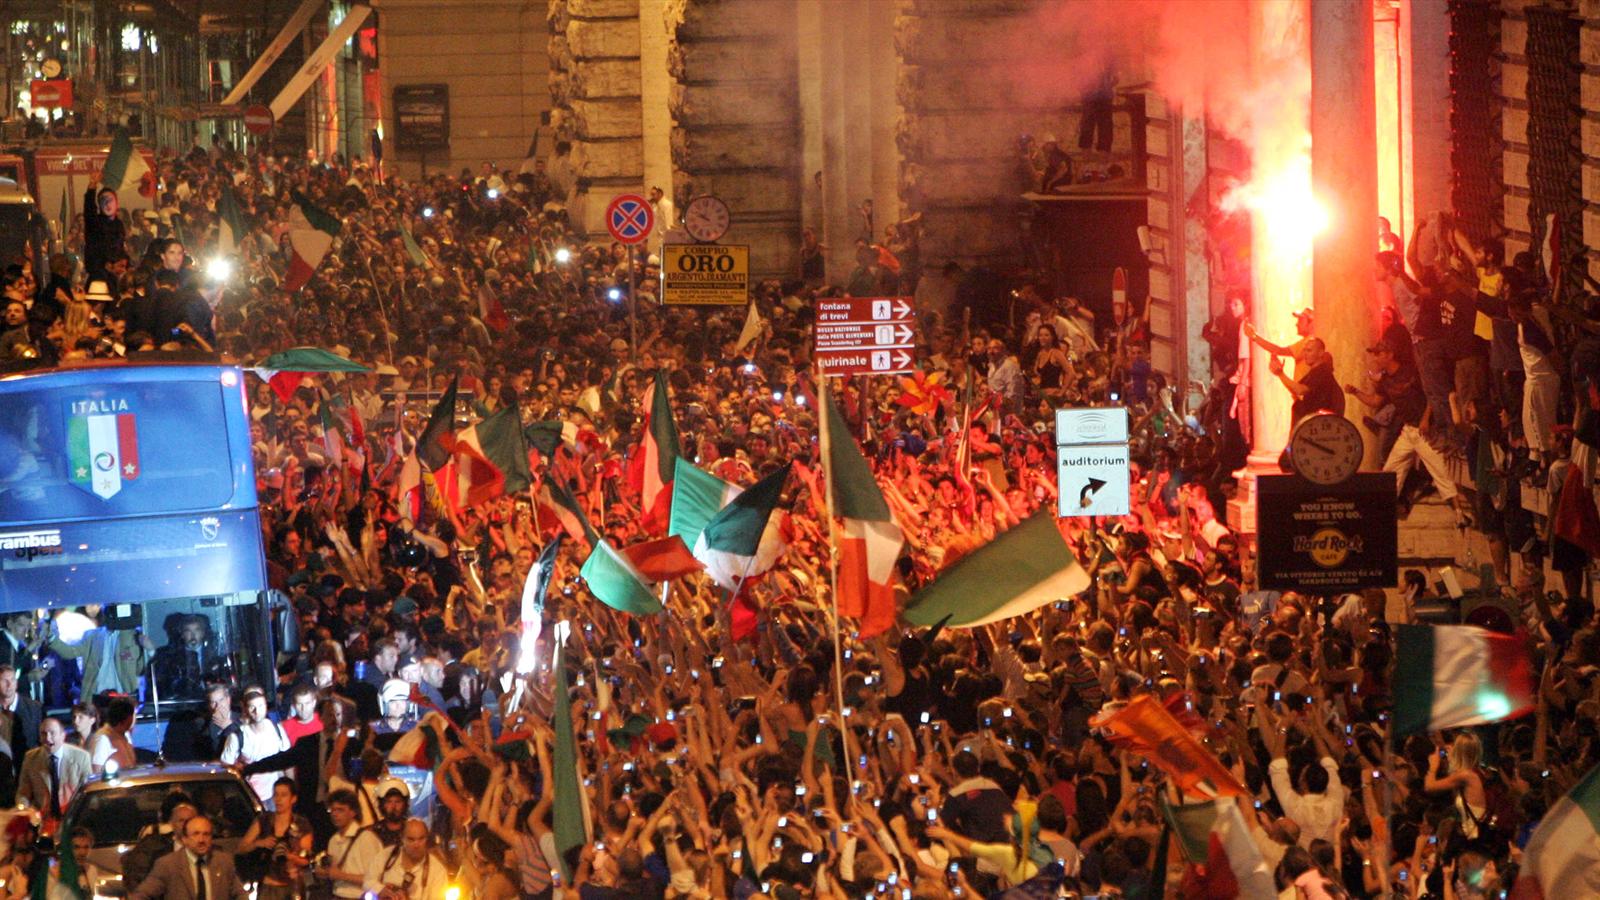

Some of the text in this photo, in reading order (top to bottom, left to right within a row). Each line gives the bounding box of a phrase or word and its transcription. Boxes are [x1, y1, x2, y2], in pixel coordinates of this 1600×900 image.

[678, 254, 735, 272] ORO
[71, 399, 128, 414] ITALIA
[1062, 457, 1125, 466] auditorium
[1300, 502, 1355, 511] YOU KNOW
[1293, 512, 1329, 520] WHERE
[1331, 511, 1344, 519] TO
[1293, 534, 1364, 552] Hard Rock
